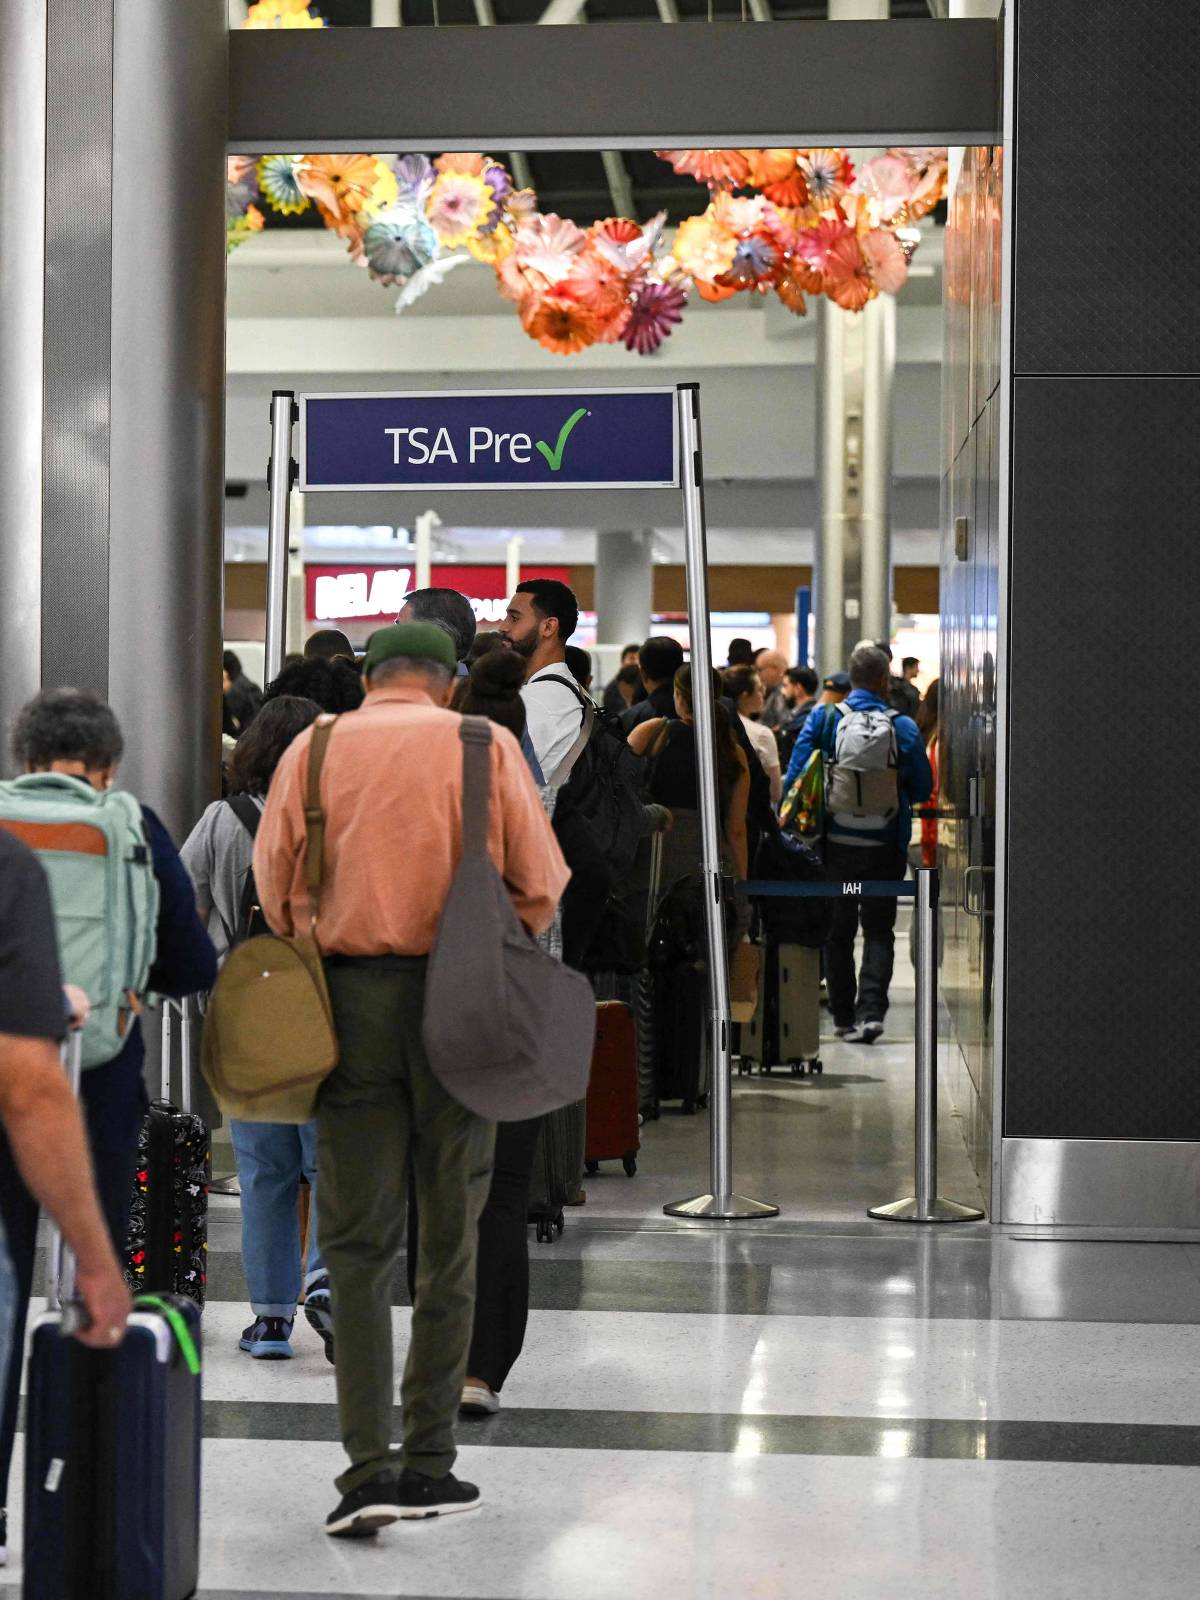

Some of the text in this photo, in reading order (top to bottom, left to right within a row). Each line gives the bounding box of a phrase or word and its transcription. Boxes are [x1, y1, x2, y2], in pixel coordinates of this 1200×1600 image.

[384, 426, 532, 465] TSA Pre
[842, 882, 862, 895] IAH
